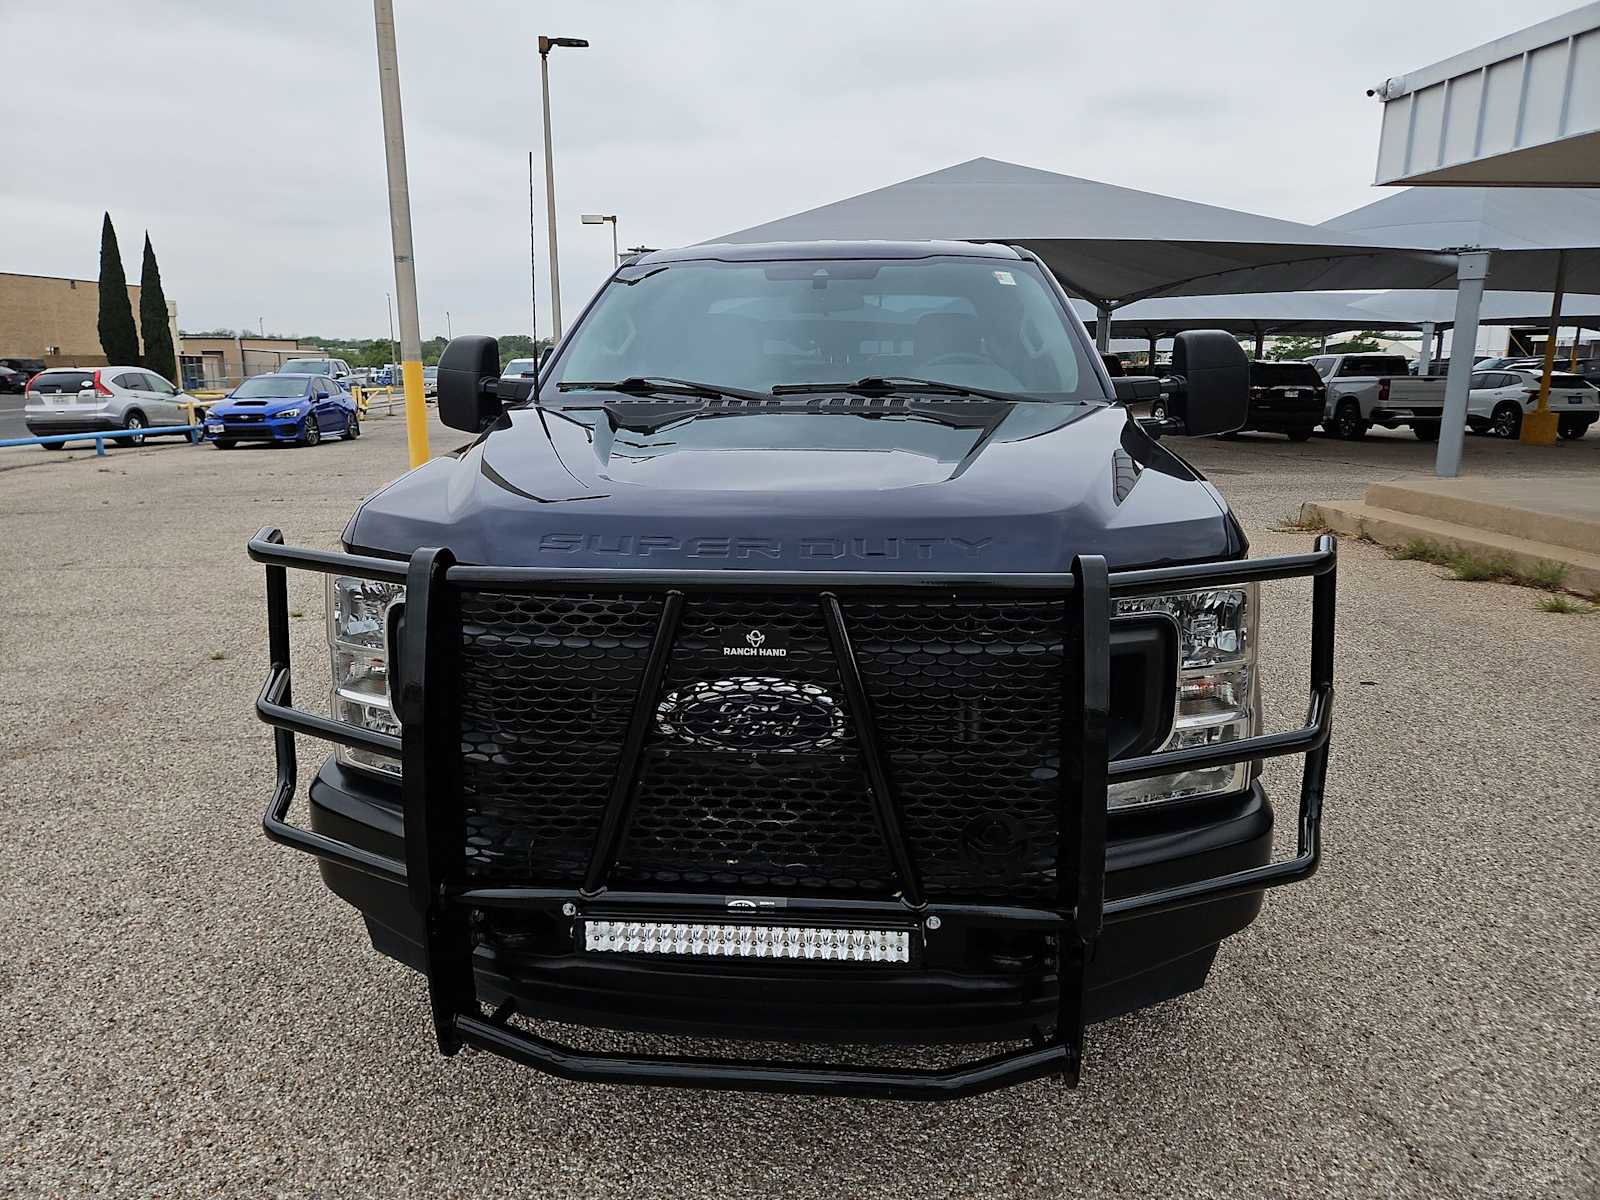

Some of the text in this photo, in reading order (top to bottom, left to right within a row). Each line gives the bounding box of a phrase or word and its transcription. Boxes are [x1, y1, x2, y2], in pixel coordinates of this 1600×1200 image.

[538, 533, 993, 560] SUPER DUTY
[723, 647, 787, 657] RANCH HAND
